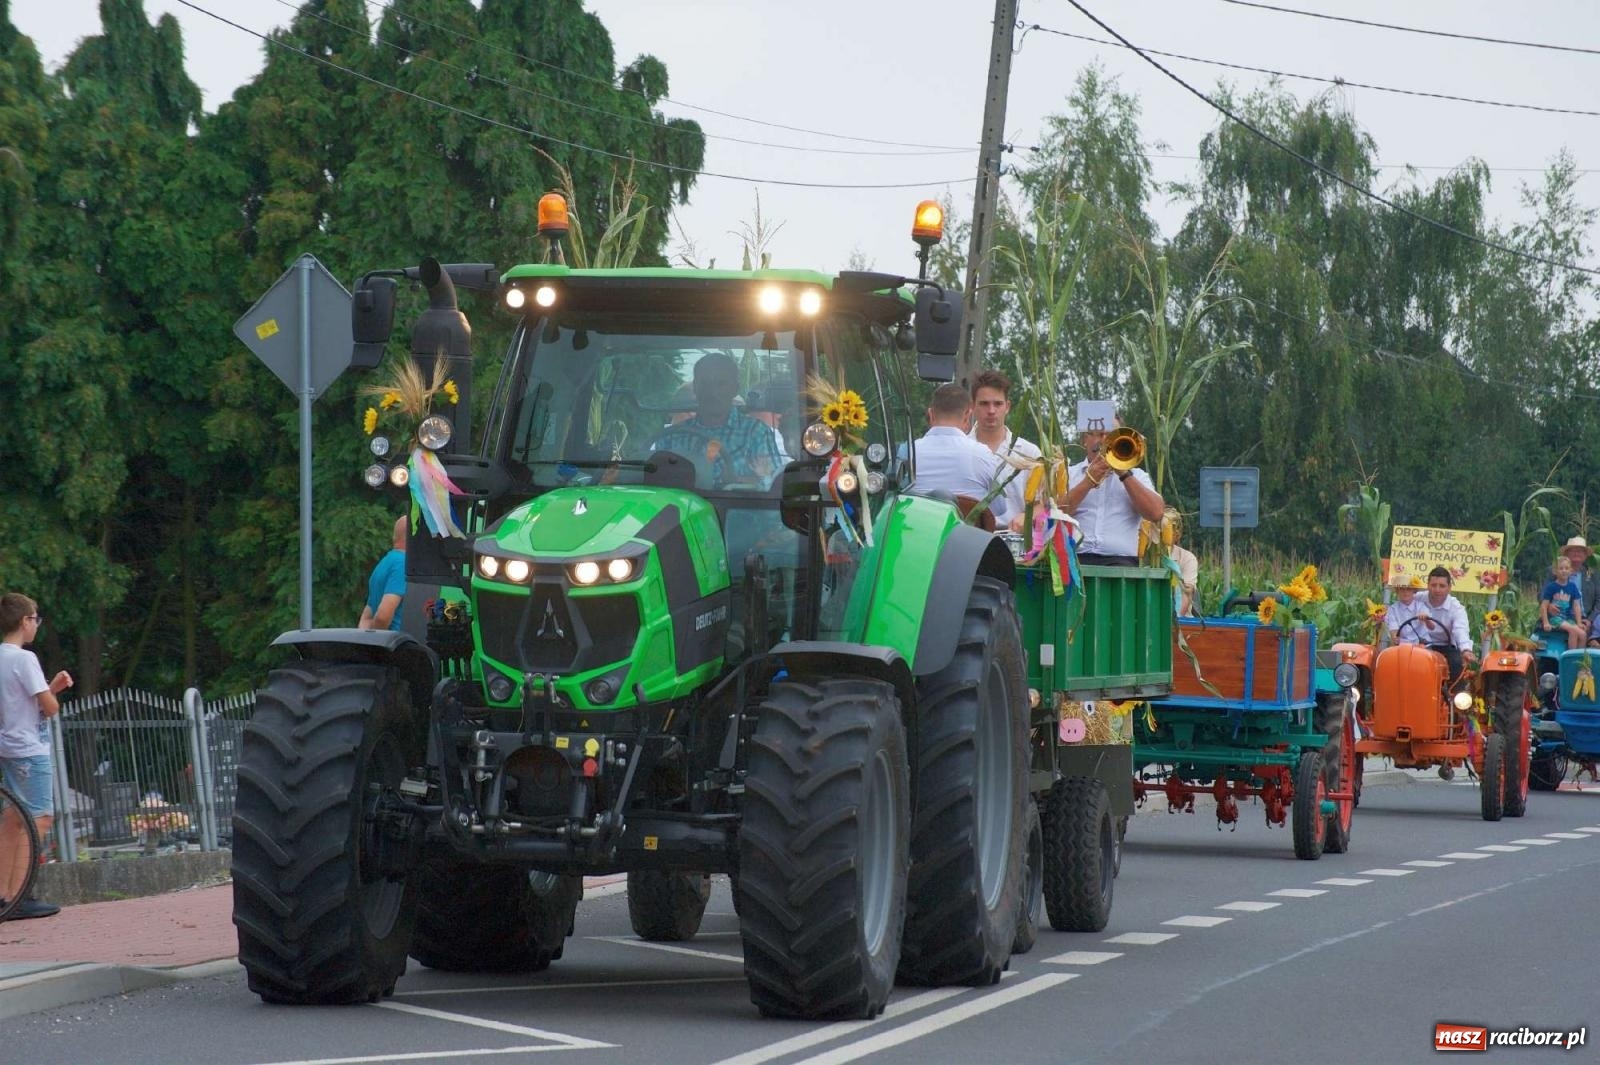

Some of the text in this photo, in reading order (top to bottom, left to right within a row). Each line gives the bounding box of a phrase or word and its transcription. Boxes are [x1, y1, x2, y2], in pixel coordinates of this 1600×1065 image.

[1395, 540, 1478, 554] JAKO POGODA,
[1391, 549, 1498, 565] TAKIM TRAKTOREM
[1413, 562, 1428, 572] TO
